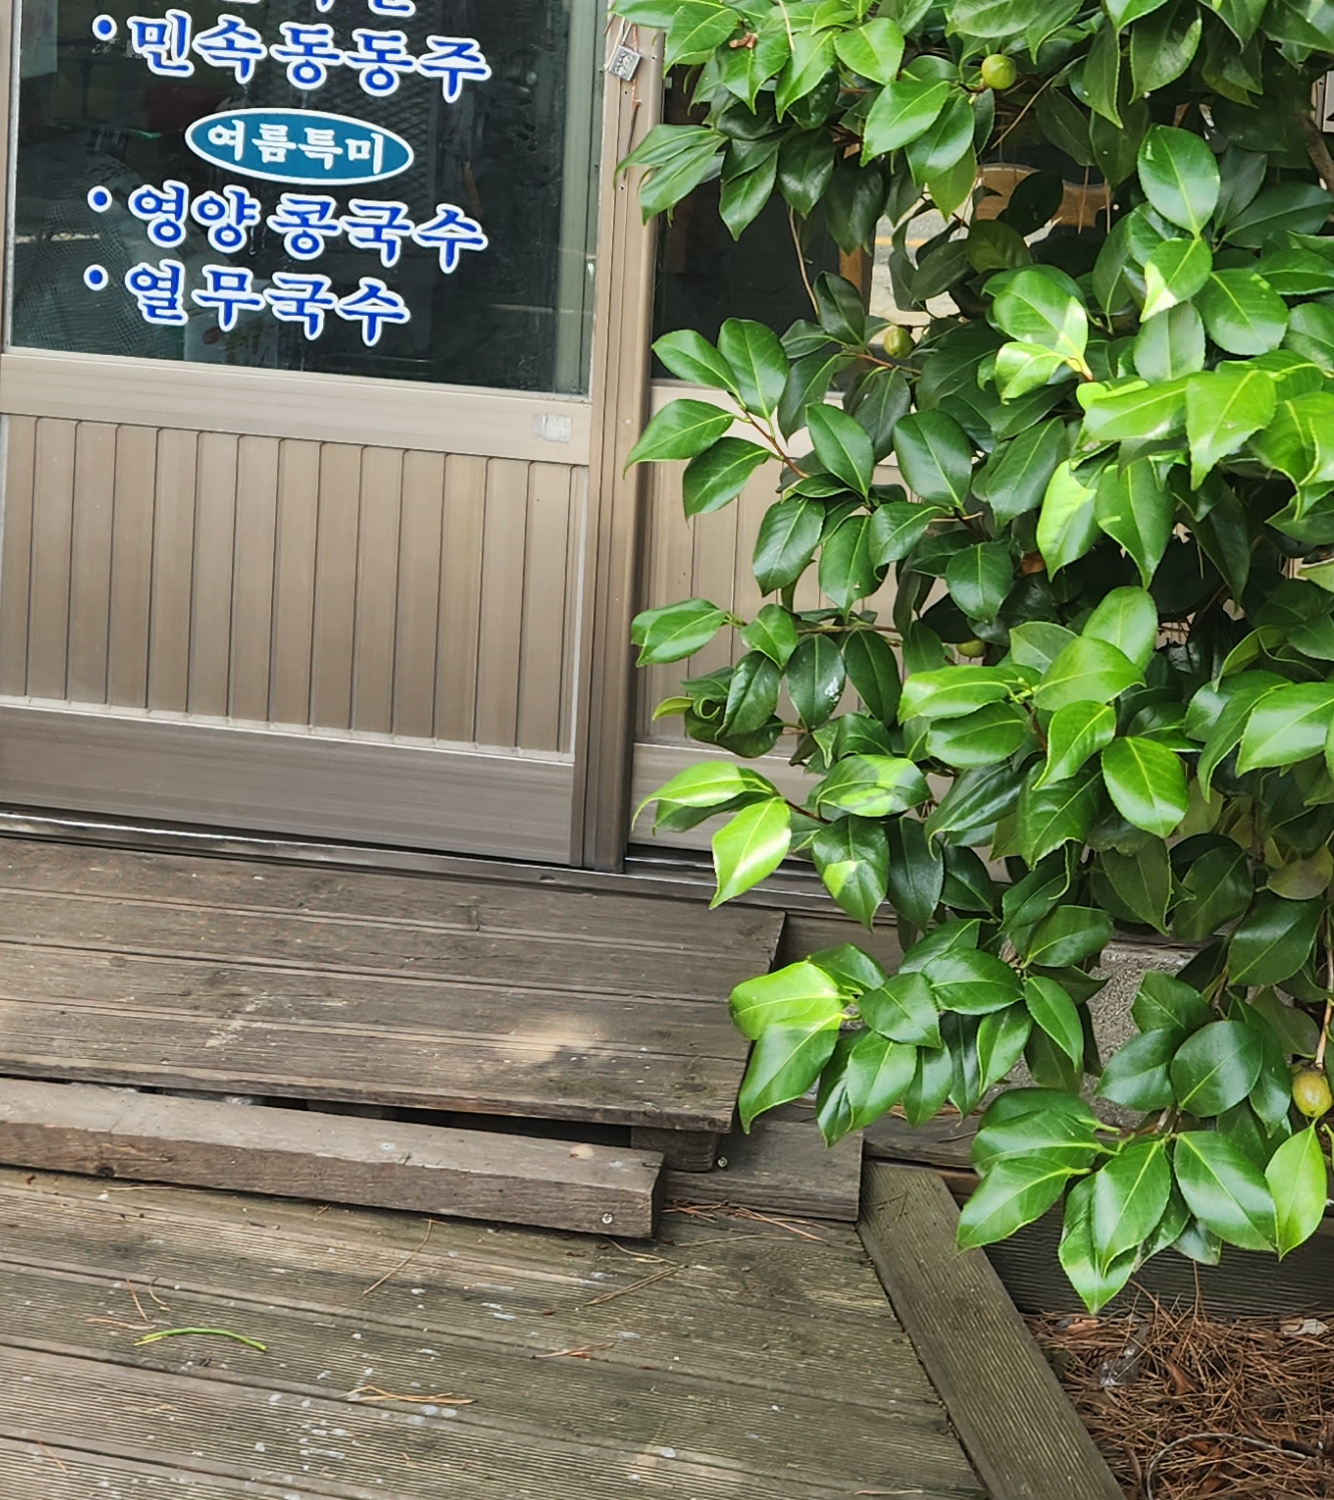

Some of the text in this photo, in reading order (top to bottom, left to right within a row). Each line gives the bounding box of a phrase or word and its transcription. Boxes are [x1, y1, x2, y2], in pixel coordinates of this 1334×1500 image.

[130, 10, 491, 101] 민속동동주
[207, 119, 384, 175] 여름특미
[129, 182, 489, 272] 영양콩국수
[125, 261, 410, 346] 열무국수
